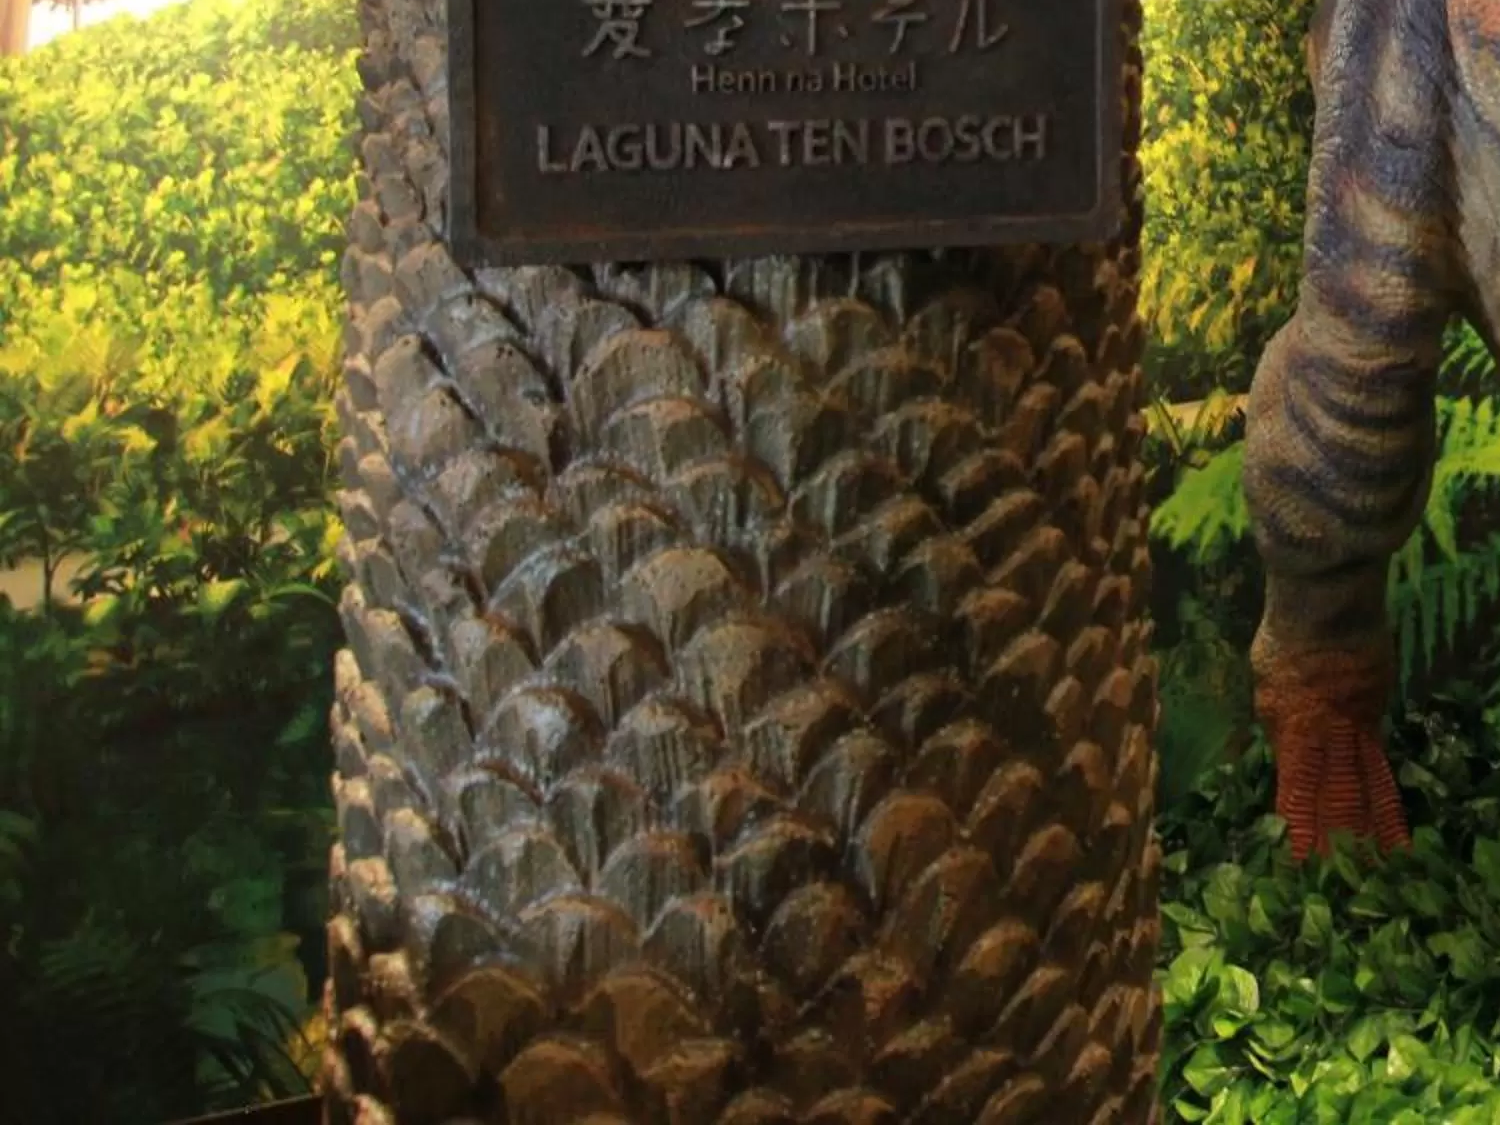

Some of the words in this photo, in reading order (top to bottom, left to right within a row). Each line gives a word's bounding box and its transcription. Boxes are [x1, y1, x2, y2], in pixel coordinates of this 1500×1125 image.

[691, 63, 777, 95] Henn
[787, 69, 823, 93] na
[833, 60, 917, 93] Hotel
[536, 121, 760, 174] LAGUNA
[768, 118, 868, 168] TEN
[884, 113, 1048, 165] BOSCH
